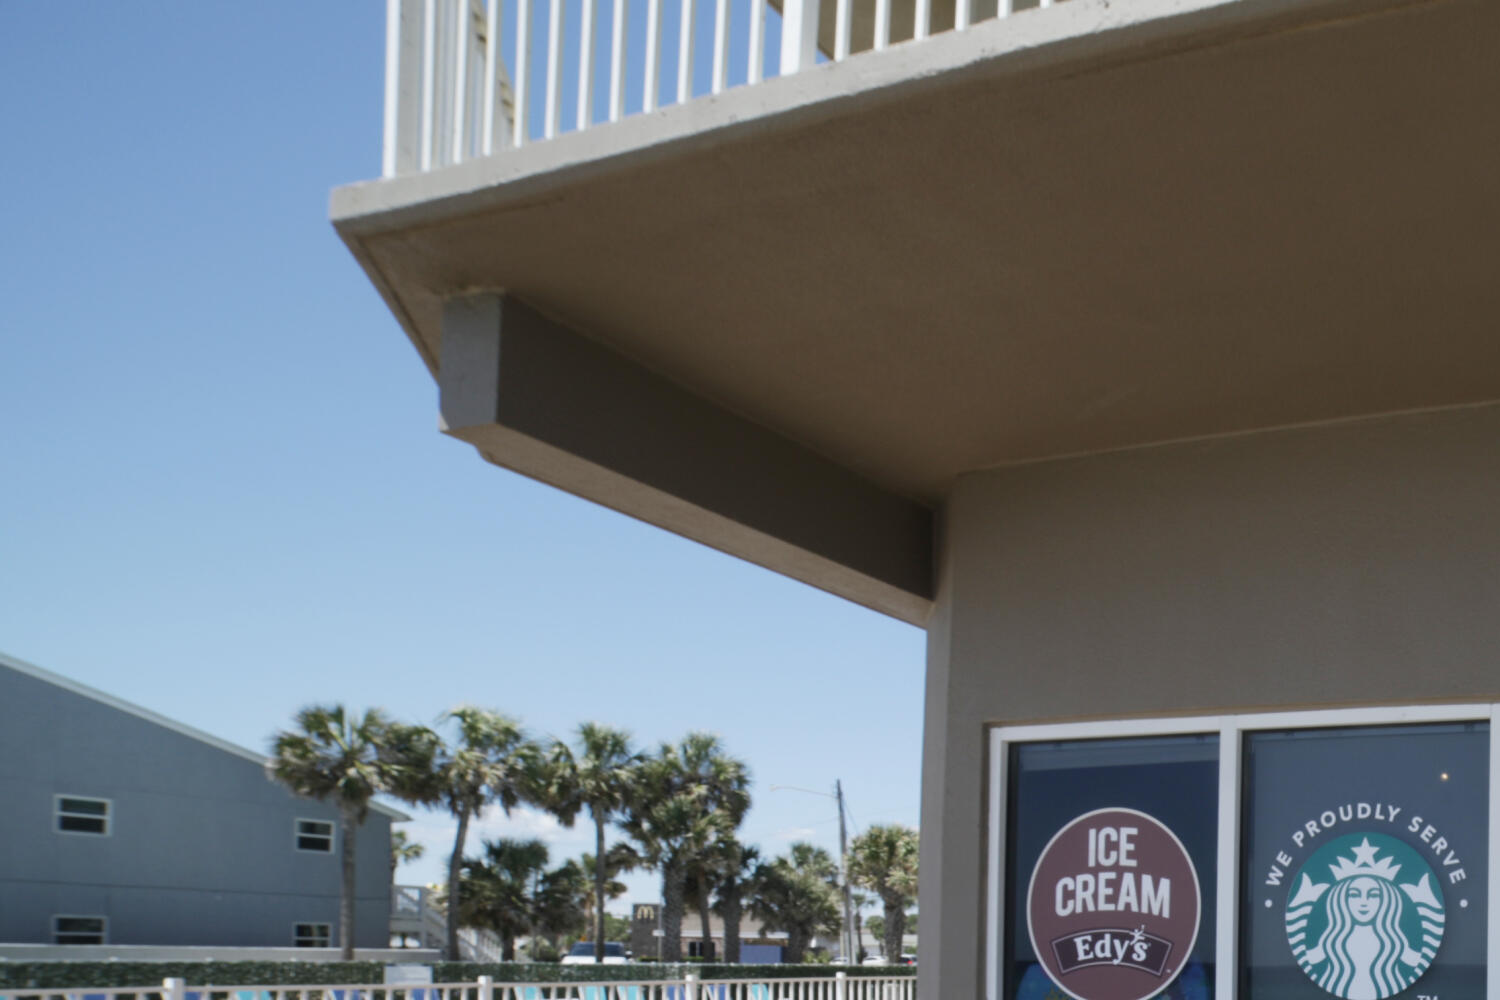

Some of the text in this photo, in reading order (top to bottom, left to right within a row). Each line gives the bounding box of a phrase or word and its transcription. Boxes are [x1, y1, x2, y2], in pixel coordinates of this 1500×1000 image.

[1088, 827, 1138, 868] ICE
[1265, 803, 1467, 887] WE PROUDLY SERVE
[1055, 872, 1171, 919] CREAM
[1073, 928, 1149, 965] Edy's
